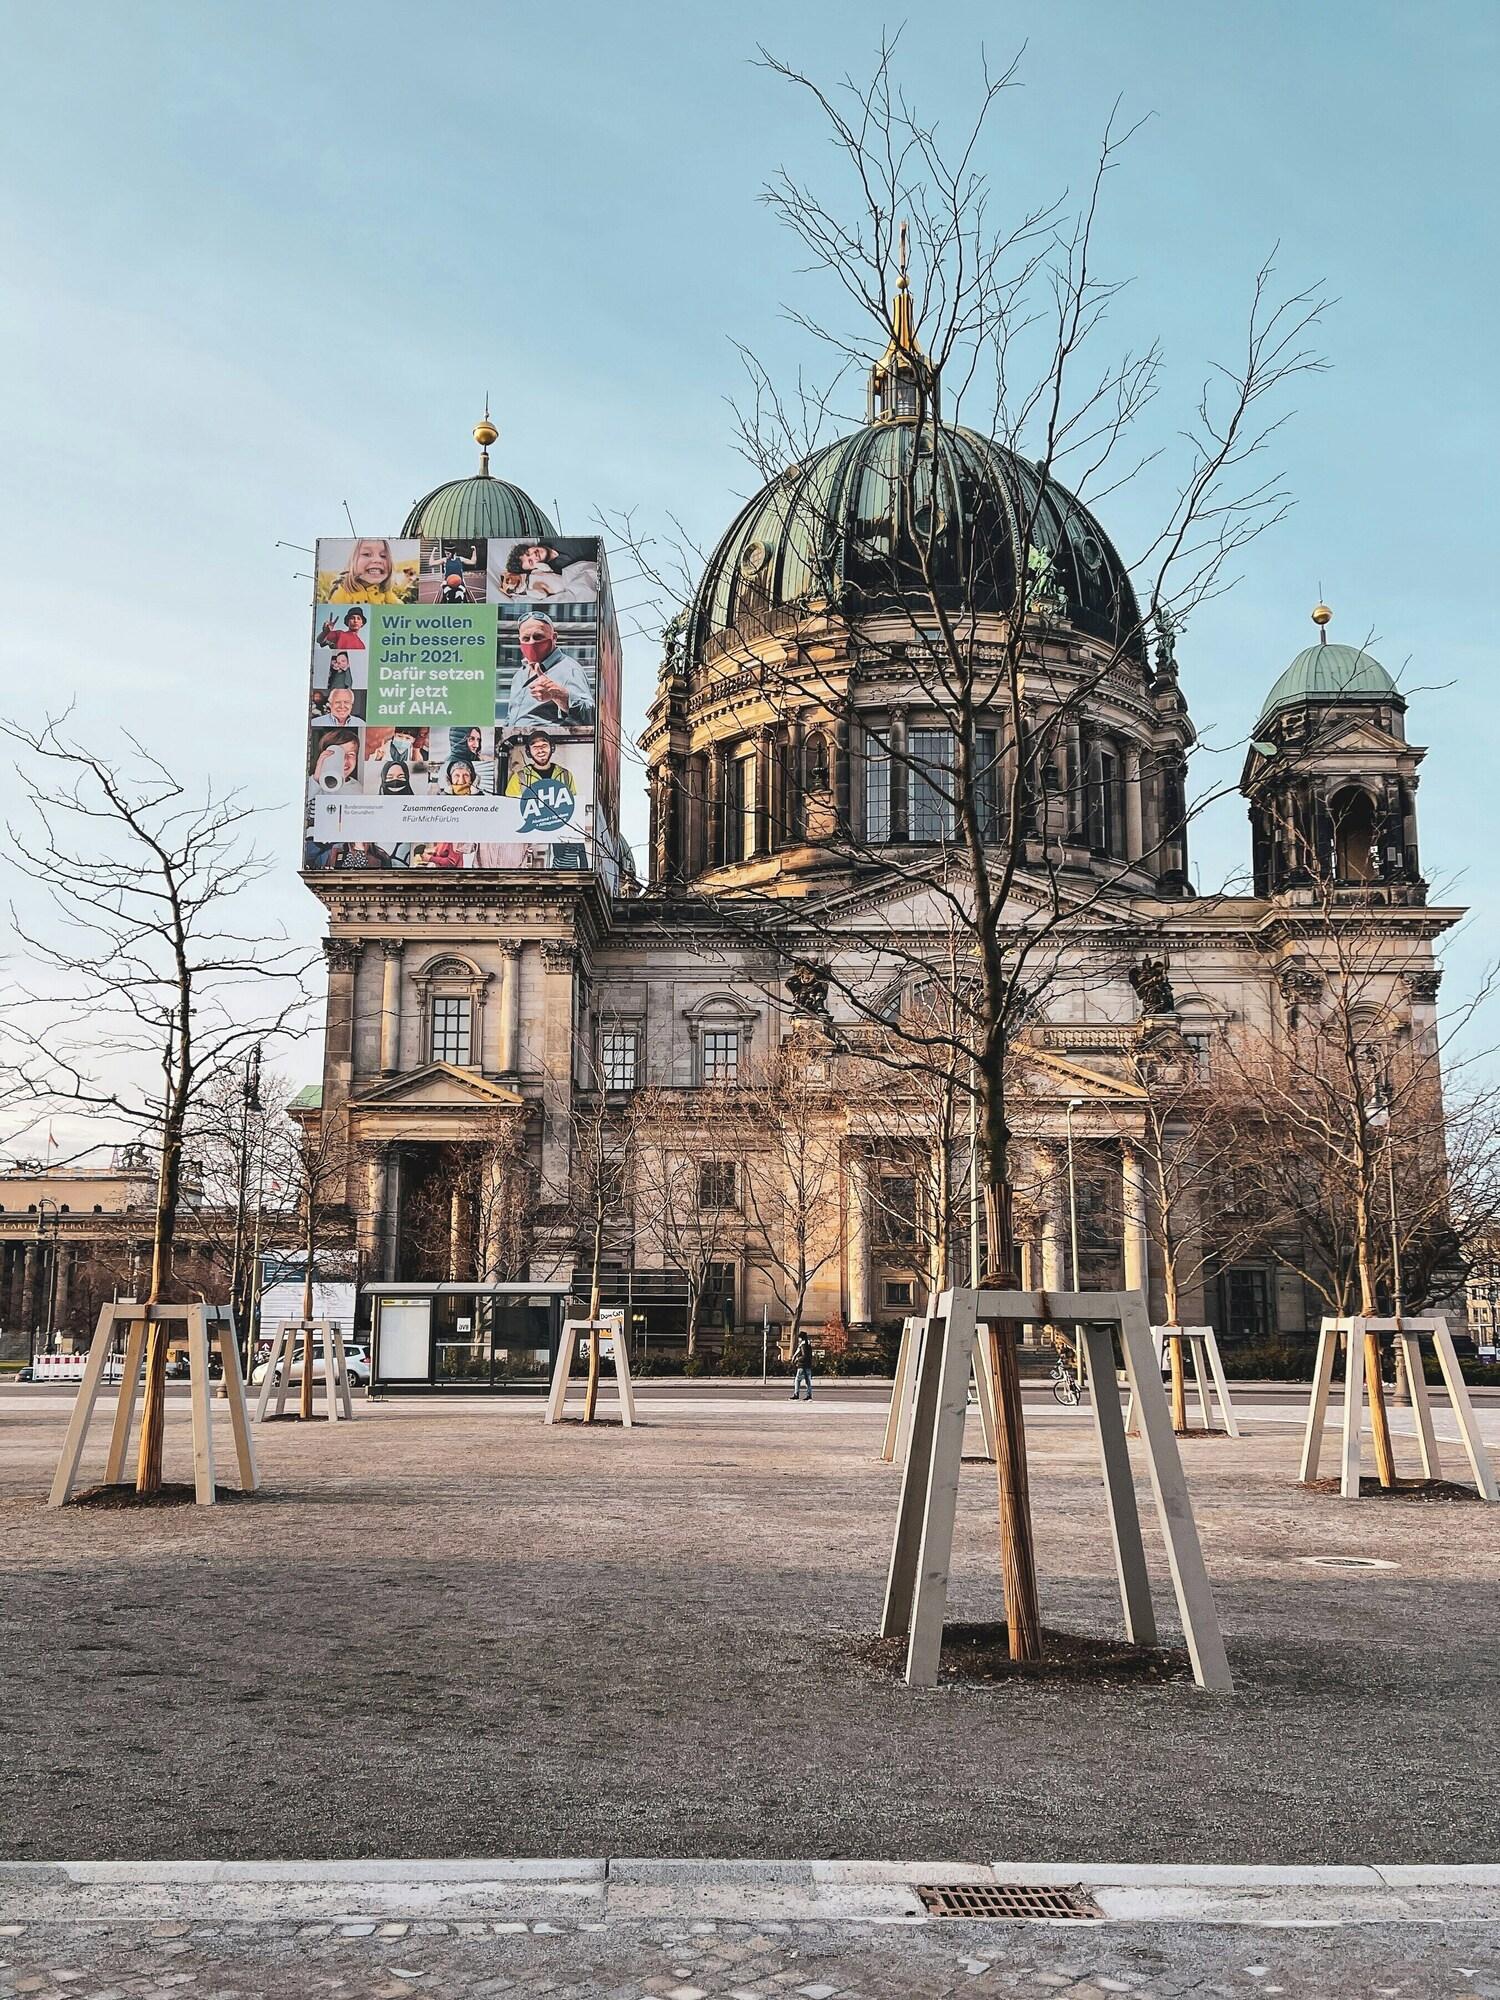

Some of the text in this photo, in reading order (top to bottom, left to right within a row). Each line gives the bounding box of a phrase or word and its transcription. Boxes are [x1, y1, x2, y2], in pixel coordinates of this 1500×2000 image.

[382, 616, 473, 629] Wir wollen
[381, 633, 486, 646] ein besseres
[380, 650, 463, 663] Jahr 2021.
[379, 667, 485, 680] Dafür setzen
[379, 684, 448, 701] wir jetzt
[378, 701, 452, 715] auf AHA.
[402, 803, 499, 814] ZusammenGegenCorona.de
[523, 786, 573, 819] AHA
